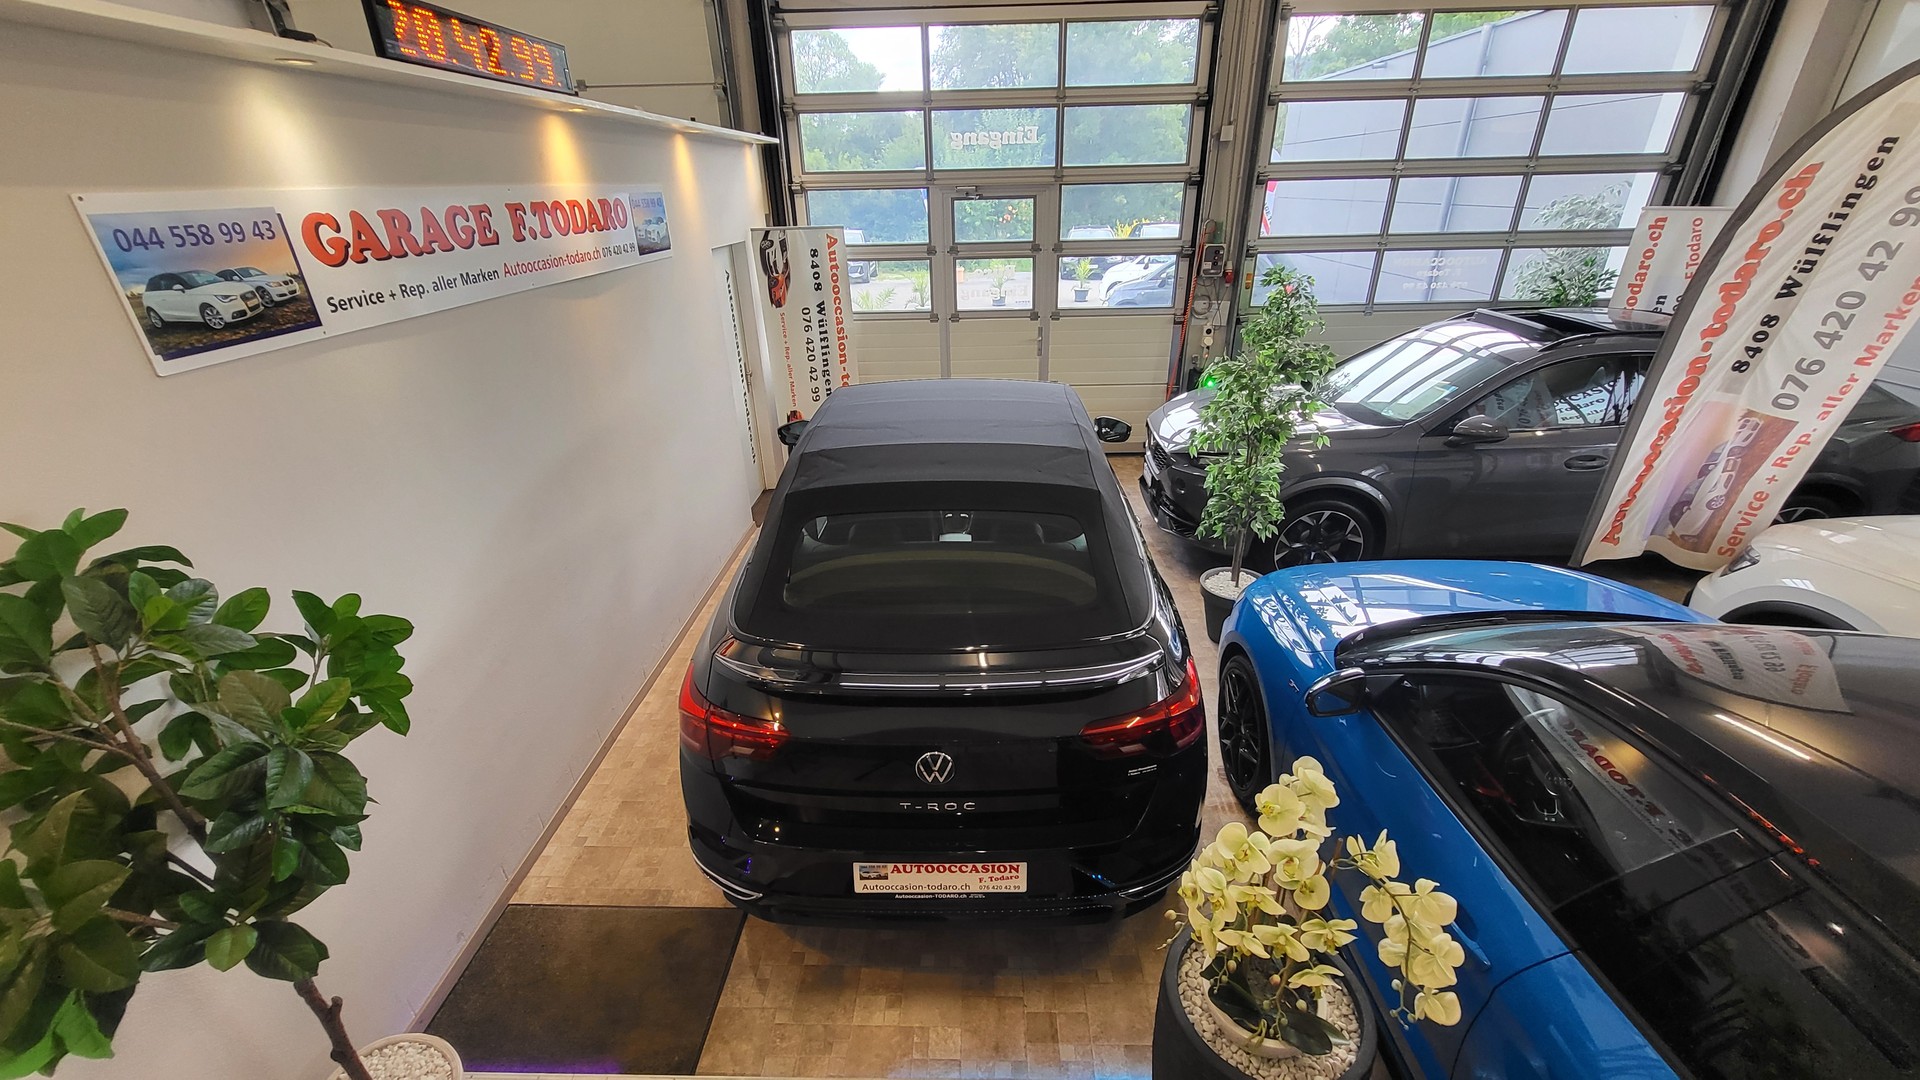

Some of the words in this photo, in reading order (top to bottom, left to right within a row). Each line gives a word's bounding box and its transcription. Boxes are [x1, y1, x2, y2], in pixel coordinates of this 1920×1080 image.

[112, 227, 165, 253] 044
[168, 224, 215, 248] 558
[218, 222, 246, 243] 99
[252, 220, 276, 240] 43
[301, 204, 500, 268] GARAGE
[504, 198, 629, 242] F.TODARO
[1685, 217, 1703, 270] Todaro
[1731, 314, 1780, 373] 8408
[1774, 136, 1900, 300] Wülflingen
[326, 290, 385, 313] Service
[399, 283, 430, 300] Rep.
[432, 276, 458, 292] aller
[460, 269, 500, 286] Marken
[503, 246, 601, 277] Autooccasion-todaro.ch
[1624, 216, 1668, 310] odaro.ch
[802, 307, 813, 333] 076
[810, 248, 822, 292] 8408
[816, 300, 832, 397] Wülflingen
[1771, 357, 1826, 411] 076
[1813, 290, 1867, 350] 420
[1857, 240, 1905, 282] 42
[805, 337, 816, 362] 420
[809, 366, 818, 383] 42
[811, 387, 820, 402] 99
[1717, 490, 1770, 557] Service
[1771, 427, 1818, 468] Rep.
[1816, 372, 1860, 421] aller
[862, 883, 971, 891] Autooccasion-todaro.ch
[890, 864, 1020, 874] AUTOOCCASION
[988, 874, 1020, 882] Todaro
